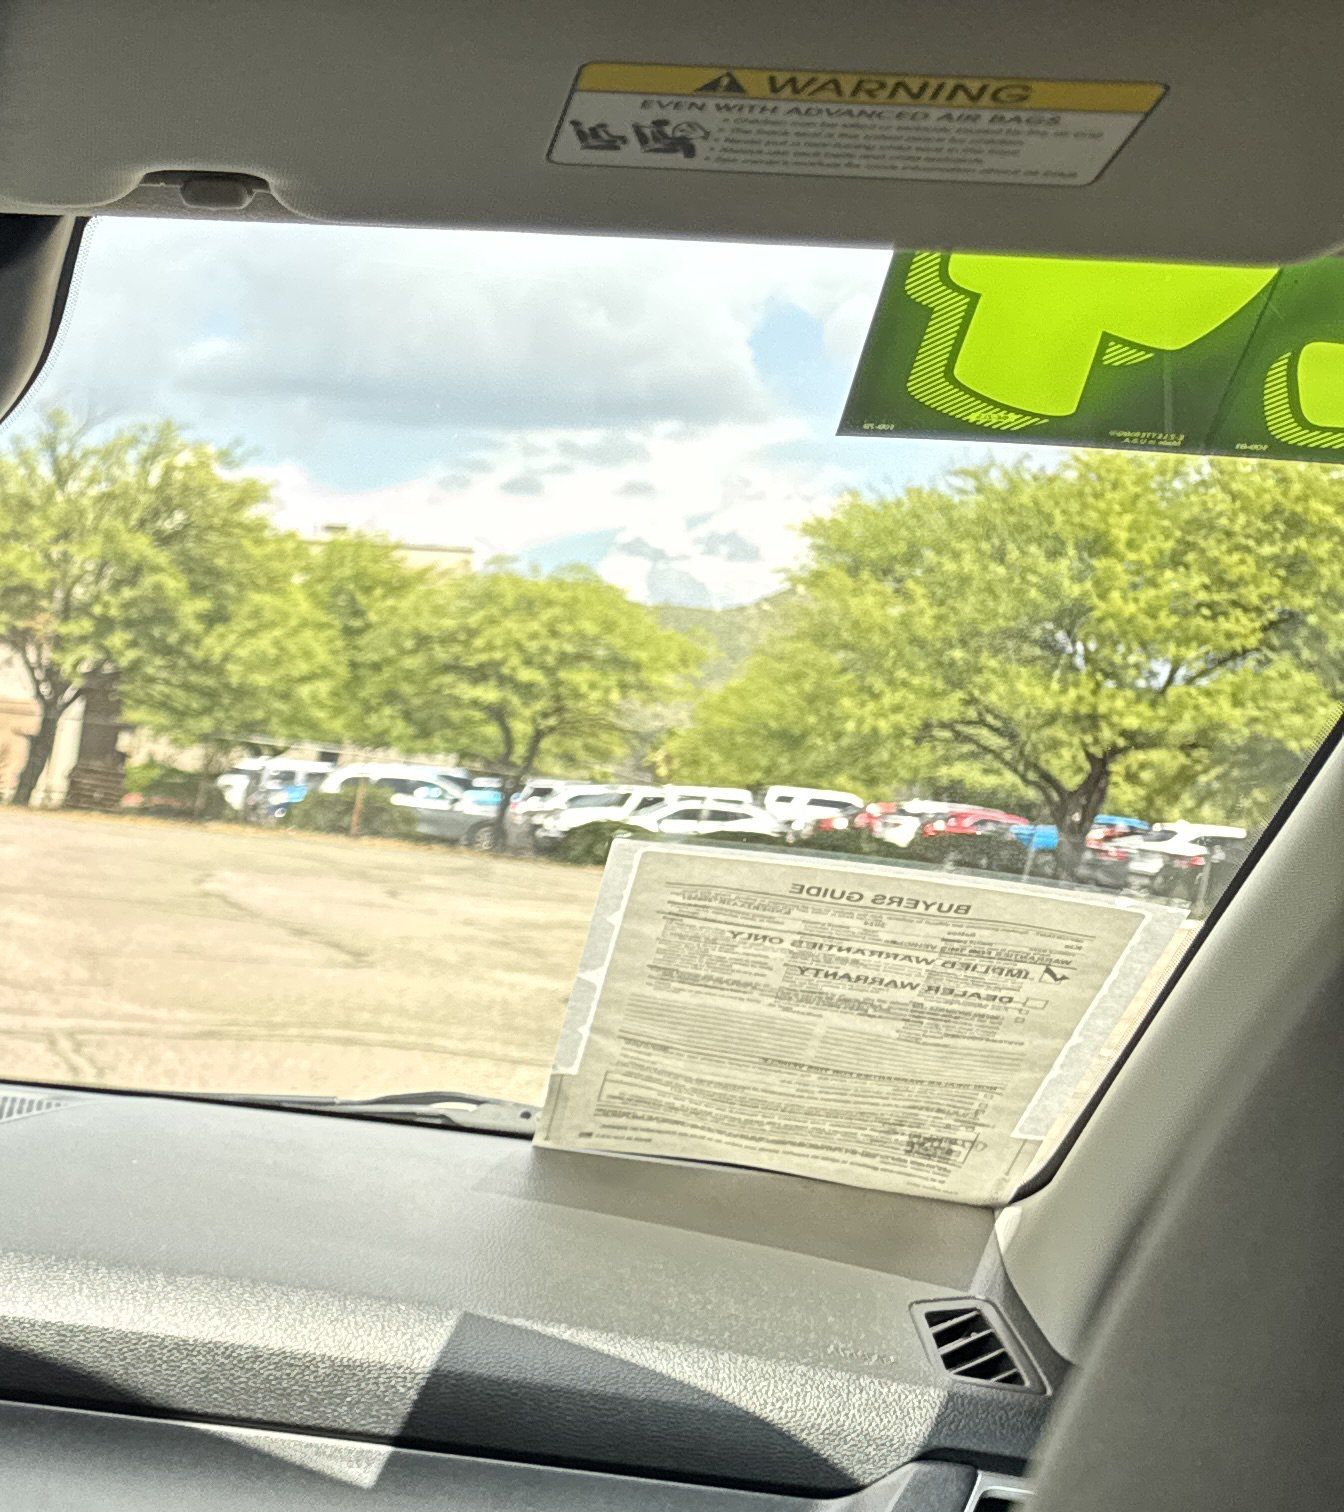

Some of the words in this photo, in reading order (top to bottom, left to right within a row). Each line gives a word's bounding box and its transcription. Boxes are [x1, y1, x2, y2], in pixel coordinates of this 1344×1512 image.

[767, 74, 1032, 103] WARNING
[640, 99, 707, 112] EVEN
[714, 102, 777, 115] WITH
[785, 105, 930, 122] ADVANCED
[936, 111, 981, 123] AIR
[988, 113, 1061, 125] BAGS
